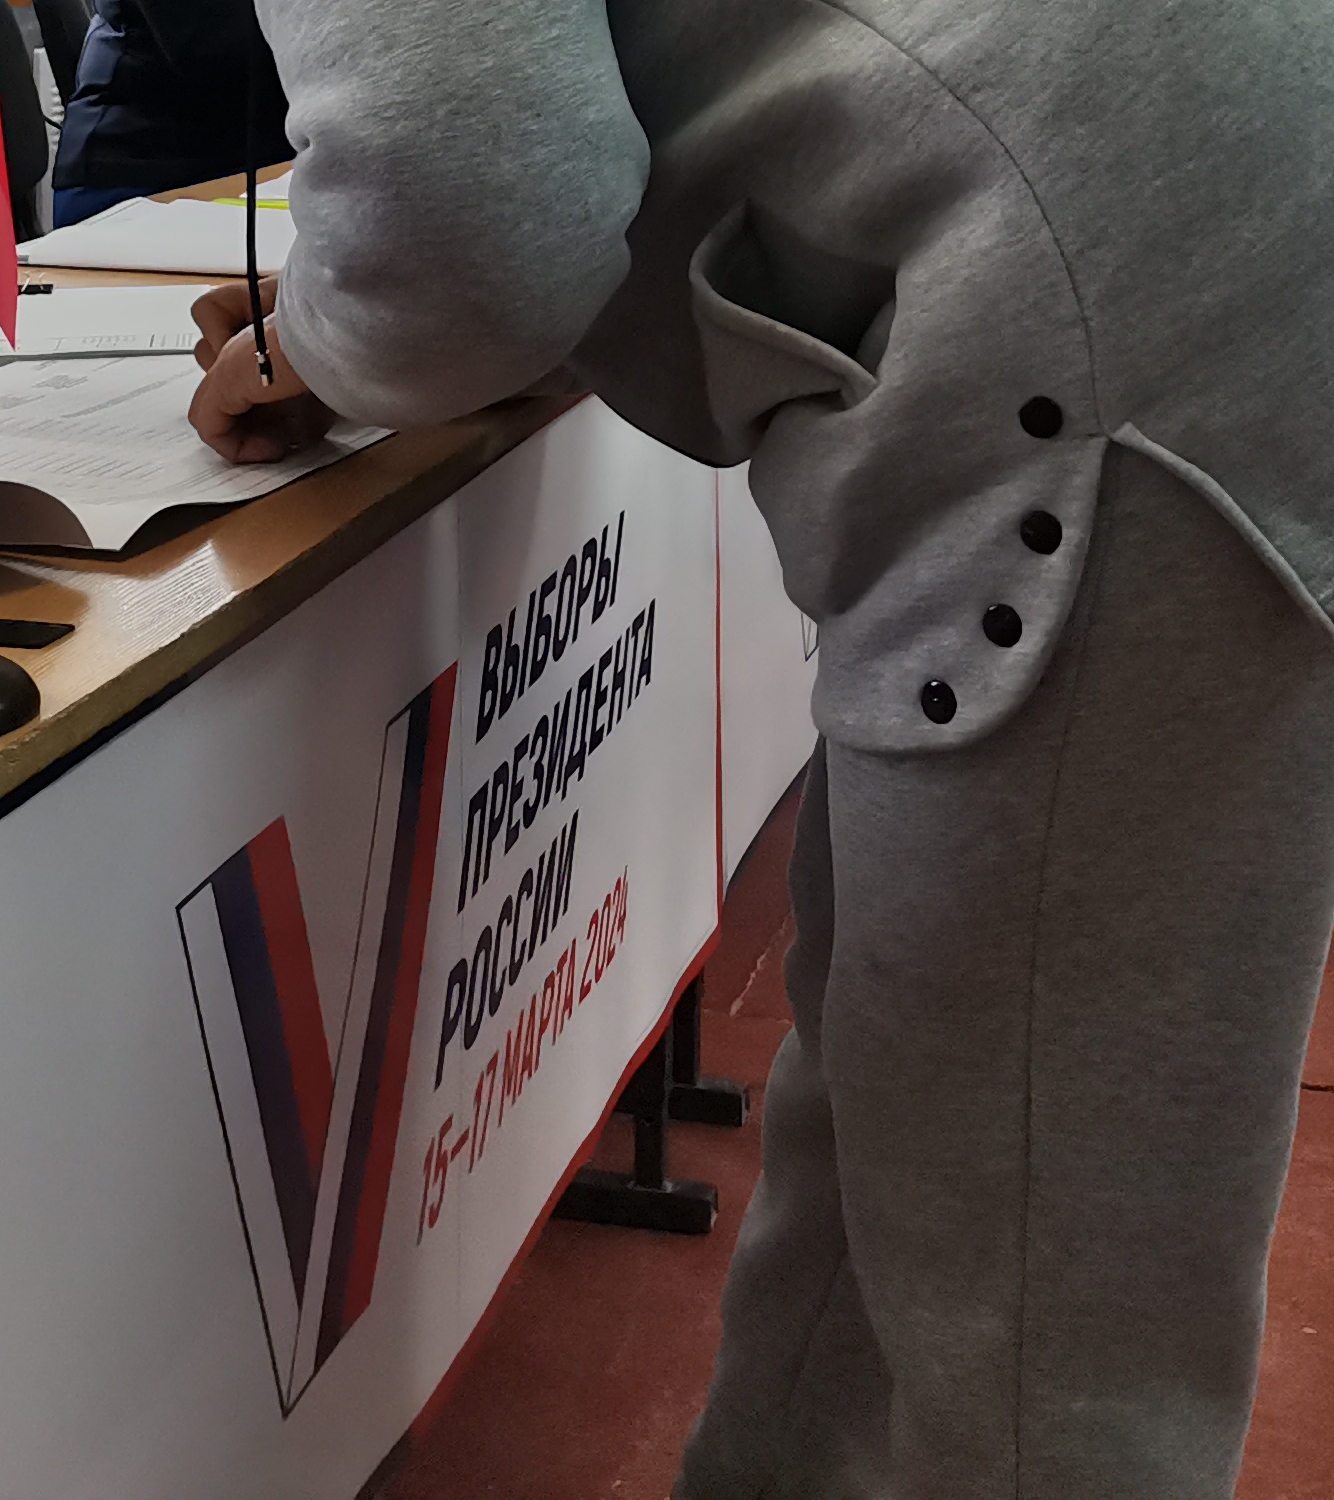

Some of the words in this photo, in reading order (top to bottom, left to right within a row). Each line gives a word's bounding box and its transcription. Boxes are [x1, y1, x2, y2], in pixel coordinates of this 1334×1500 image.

[456, 598, 656, 915] ПРЕЗИДЕНТА
[475, 510, 625, 745] ВЫБОРЫ
[433, 809, 580, 1092] РОССИИ
[497, 937, 576, 1128] МАРТА
[578, 864, 629, 1006] 2024
